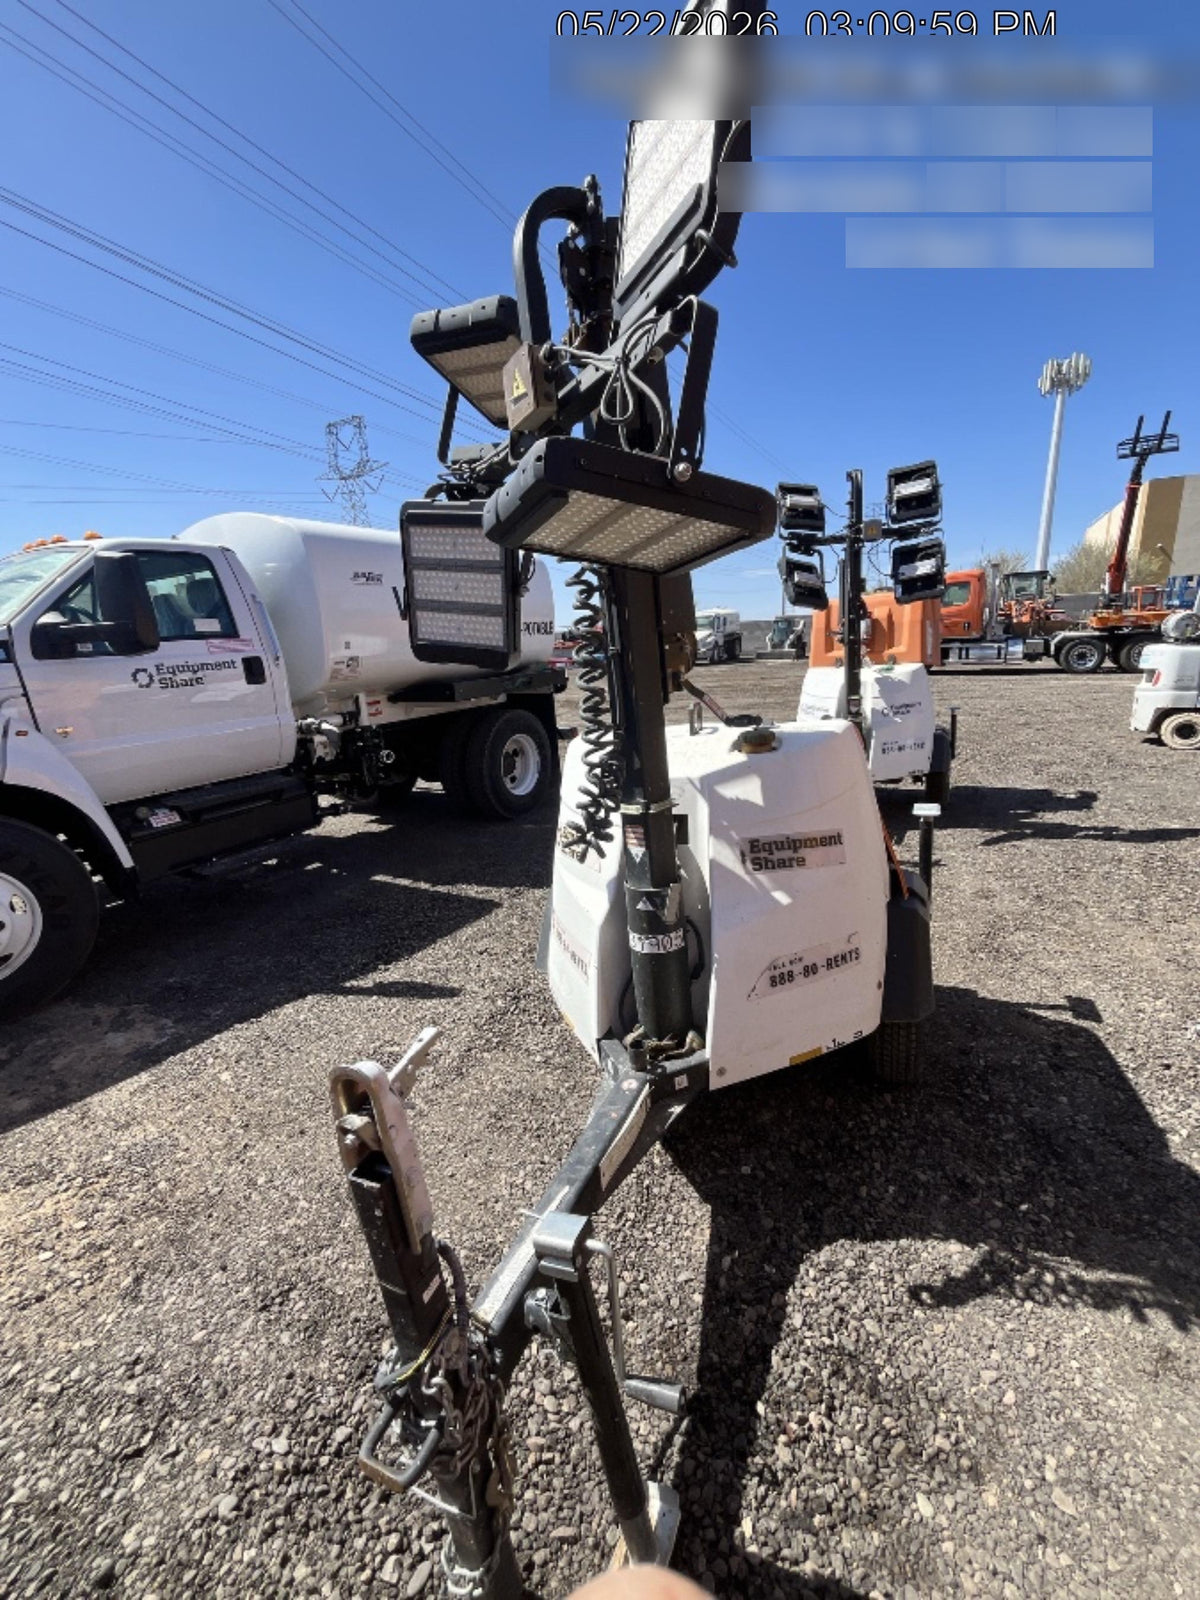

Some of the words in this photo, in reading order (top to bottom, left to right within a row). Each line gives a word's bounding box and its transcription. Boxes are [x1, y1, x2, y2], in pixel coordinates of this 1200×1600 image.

[154, 659, 237, 676] Equipment
[158, 676, 205, 689] Share
[748, 832, 844, 855] Equipment
[750, 855, 806, 871] Share
